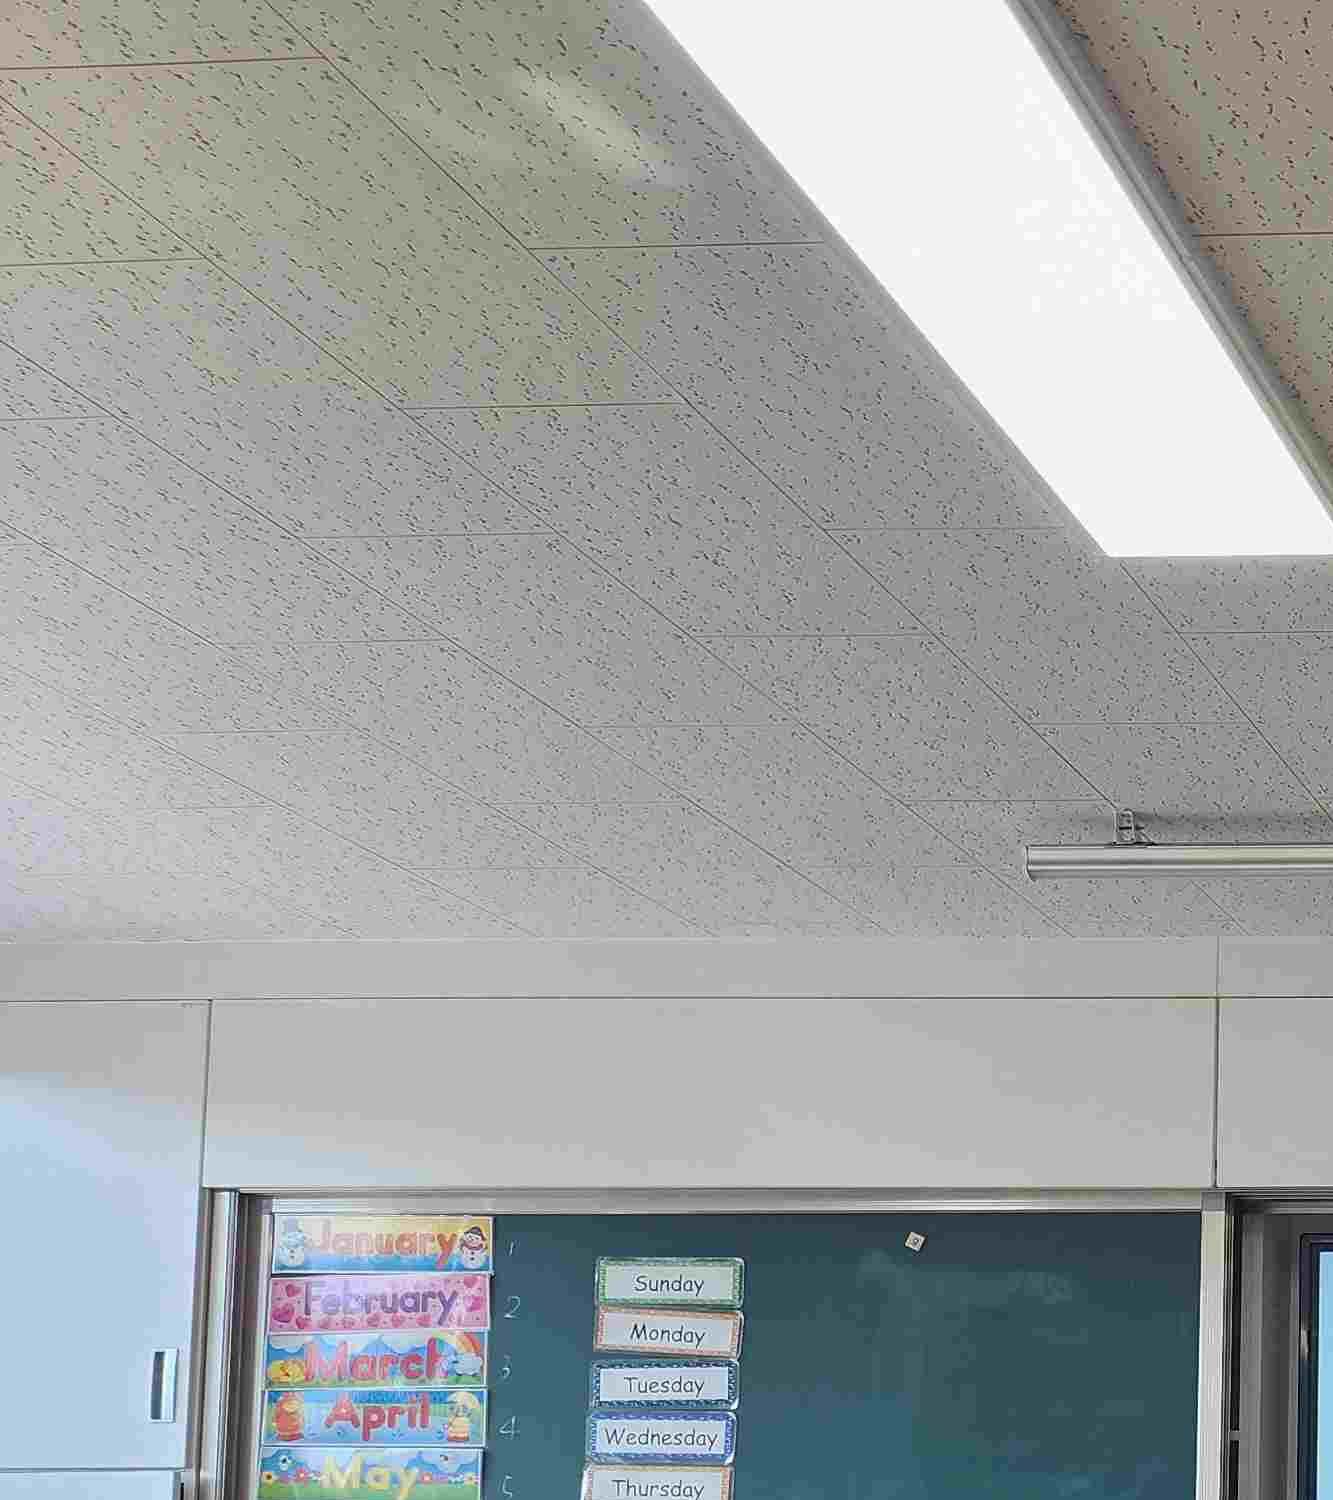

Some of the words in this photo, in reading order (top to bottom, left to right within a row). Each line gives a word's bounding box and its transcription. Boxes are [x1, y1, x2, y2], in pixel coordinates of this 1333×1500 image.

[633, 1274, 705, 1299] Sunday
[303, 1281, 458, 1327] February
[503, 1295, 521, 1319] 2
[630, 1323, 706, 1349] Monday
[303, 1336, 447, 1382] March
[624, 1376, 705, 1399] Tuesday
[324, 1391, 430, 1441] April
[500, 1415, 520, 1440] 4
[604, 1427, 719, 1451] Wednesday
